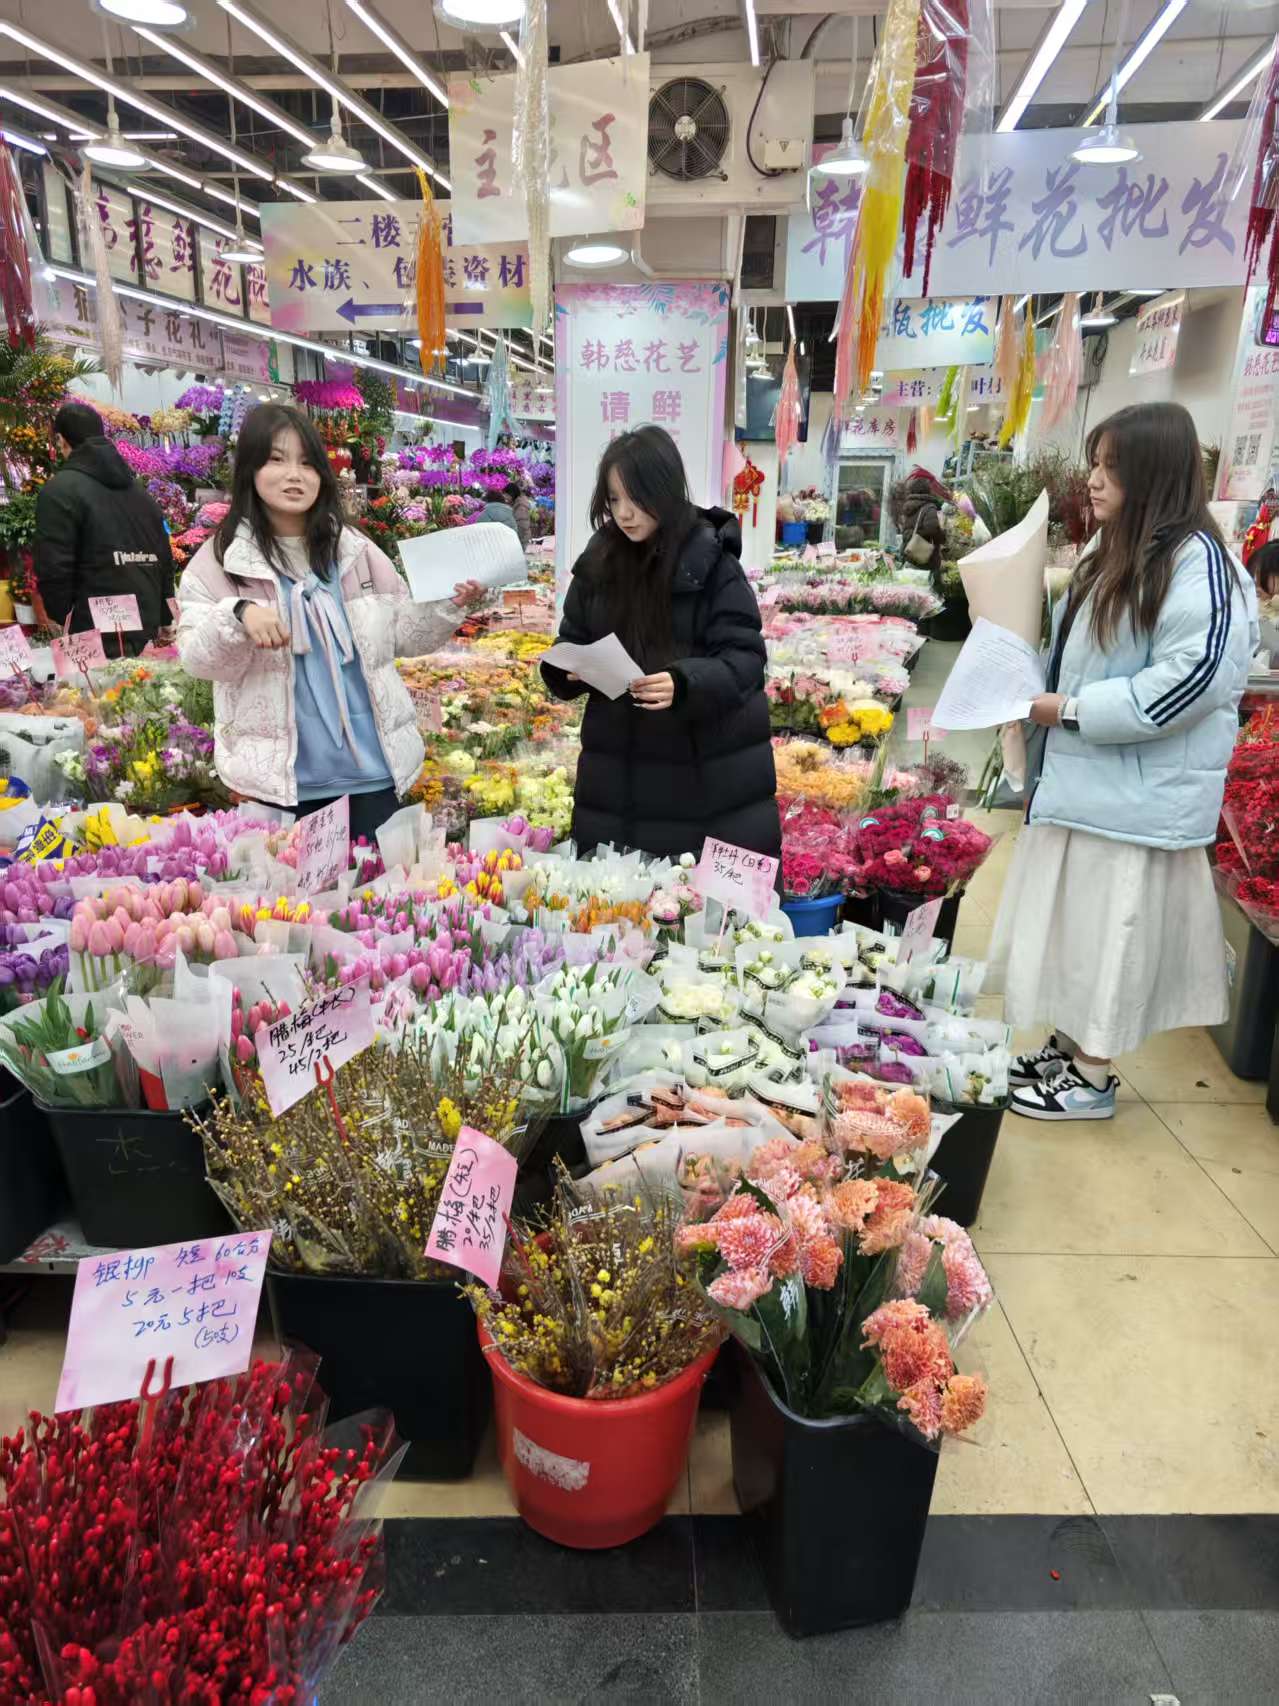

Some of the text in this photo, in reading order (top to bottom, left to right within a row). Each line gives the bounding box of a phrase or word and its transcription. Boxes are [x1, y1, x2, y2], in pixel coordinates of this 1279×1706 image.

[475, 112, 619, 199] 主区
[801, 152, 1236, 267] 韩鲜花批发
